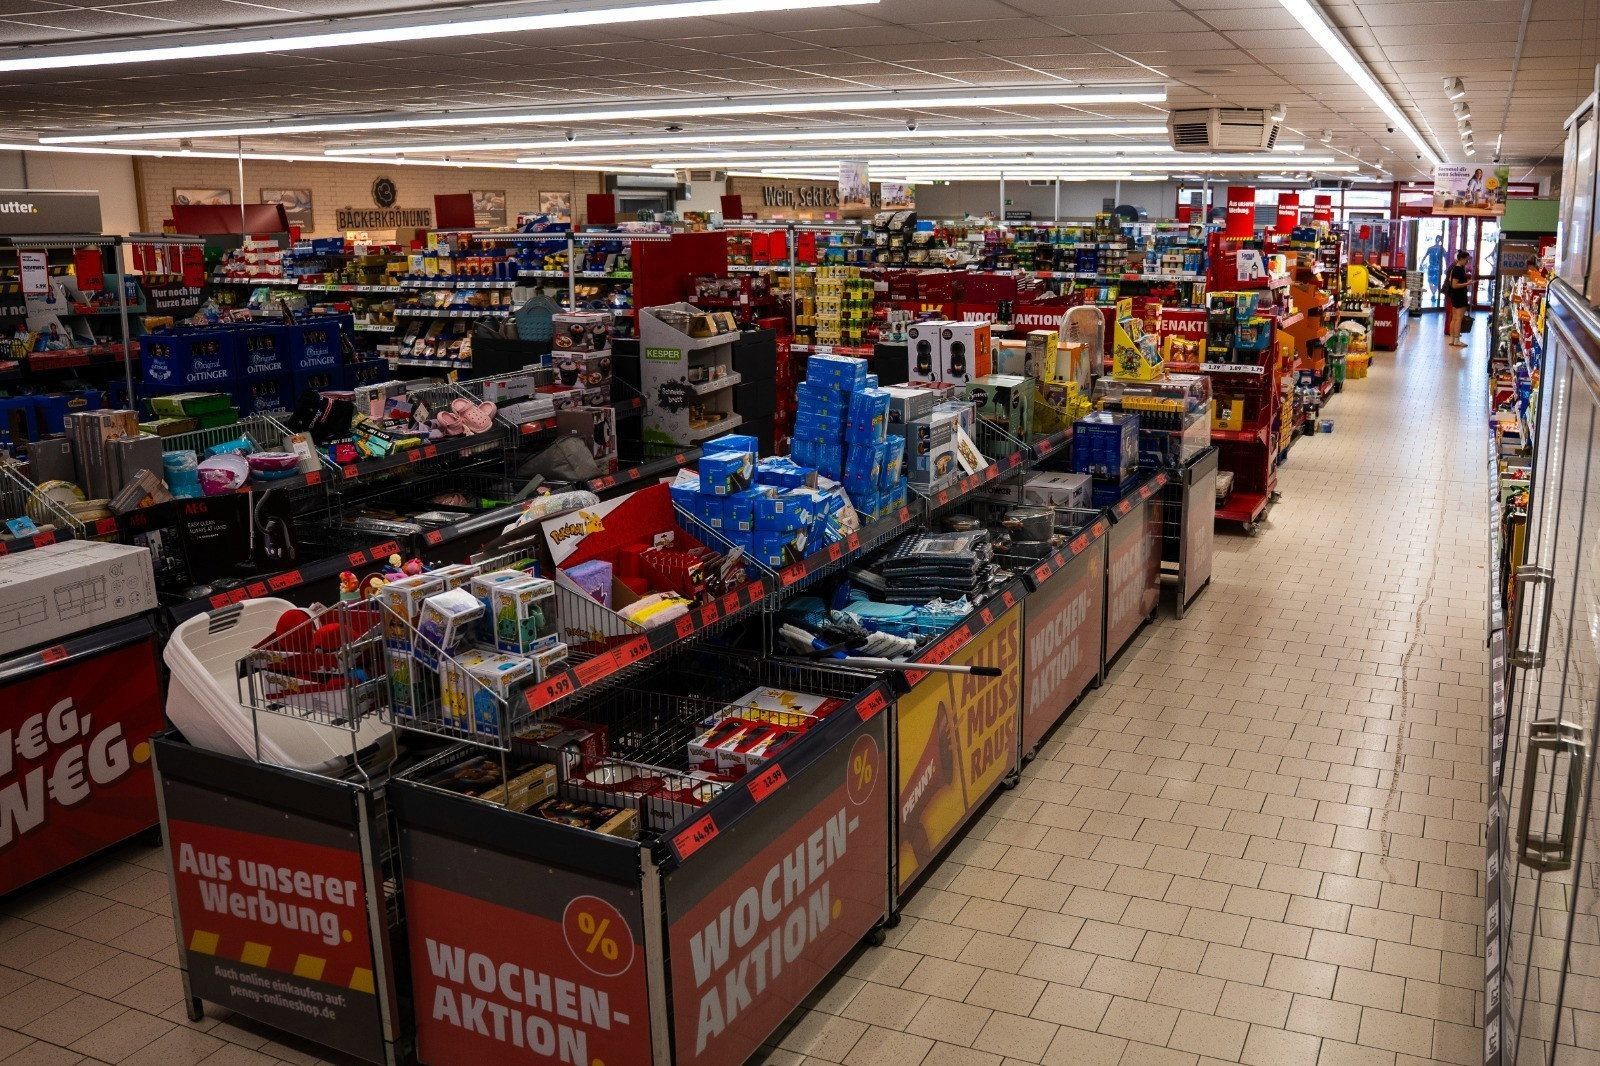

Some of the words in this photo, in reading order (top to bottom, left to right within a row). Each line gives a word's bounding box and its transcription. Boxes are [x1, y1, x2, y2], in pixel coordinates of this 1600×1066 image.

[339, 209, 430, 228] BÄCKERKRÖNUNG
[763, 185, 797, 208] Wein,
[799, 186, 823, 206] Sekt
[152, 289, 168, 298] Nur
[169, 288, 187, 297] noch
[647, 349, 680, 358] KESPER
[547, 678, 569, 697] 9.99
[966, 664, 1020, 741] MUSS
[693, 822, 714, 843] 44.99
[179, 842, 232, 882] Aus
[238, 858, 358, 907] unserer
[200, 880, 353, 946] Werbung.
[689, 807, 861, 989] WOCHEN-
[578, 911, 619, 961] %
[214, 965, 238, 983] Auch
[239, 970, 271, 989] online
[272, 979, 331, 1002] einkaufen
[331, 993, 346, 1008] auf:
[425, 937, 630, 1031] WOCHEN-
[696, 881, 843, 1058] AKTION.
[230, 986, 337, 1022] penny-onlineshop.de
[432, 985, 605, 1066] AKTION.
